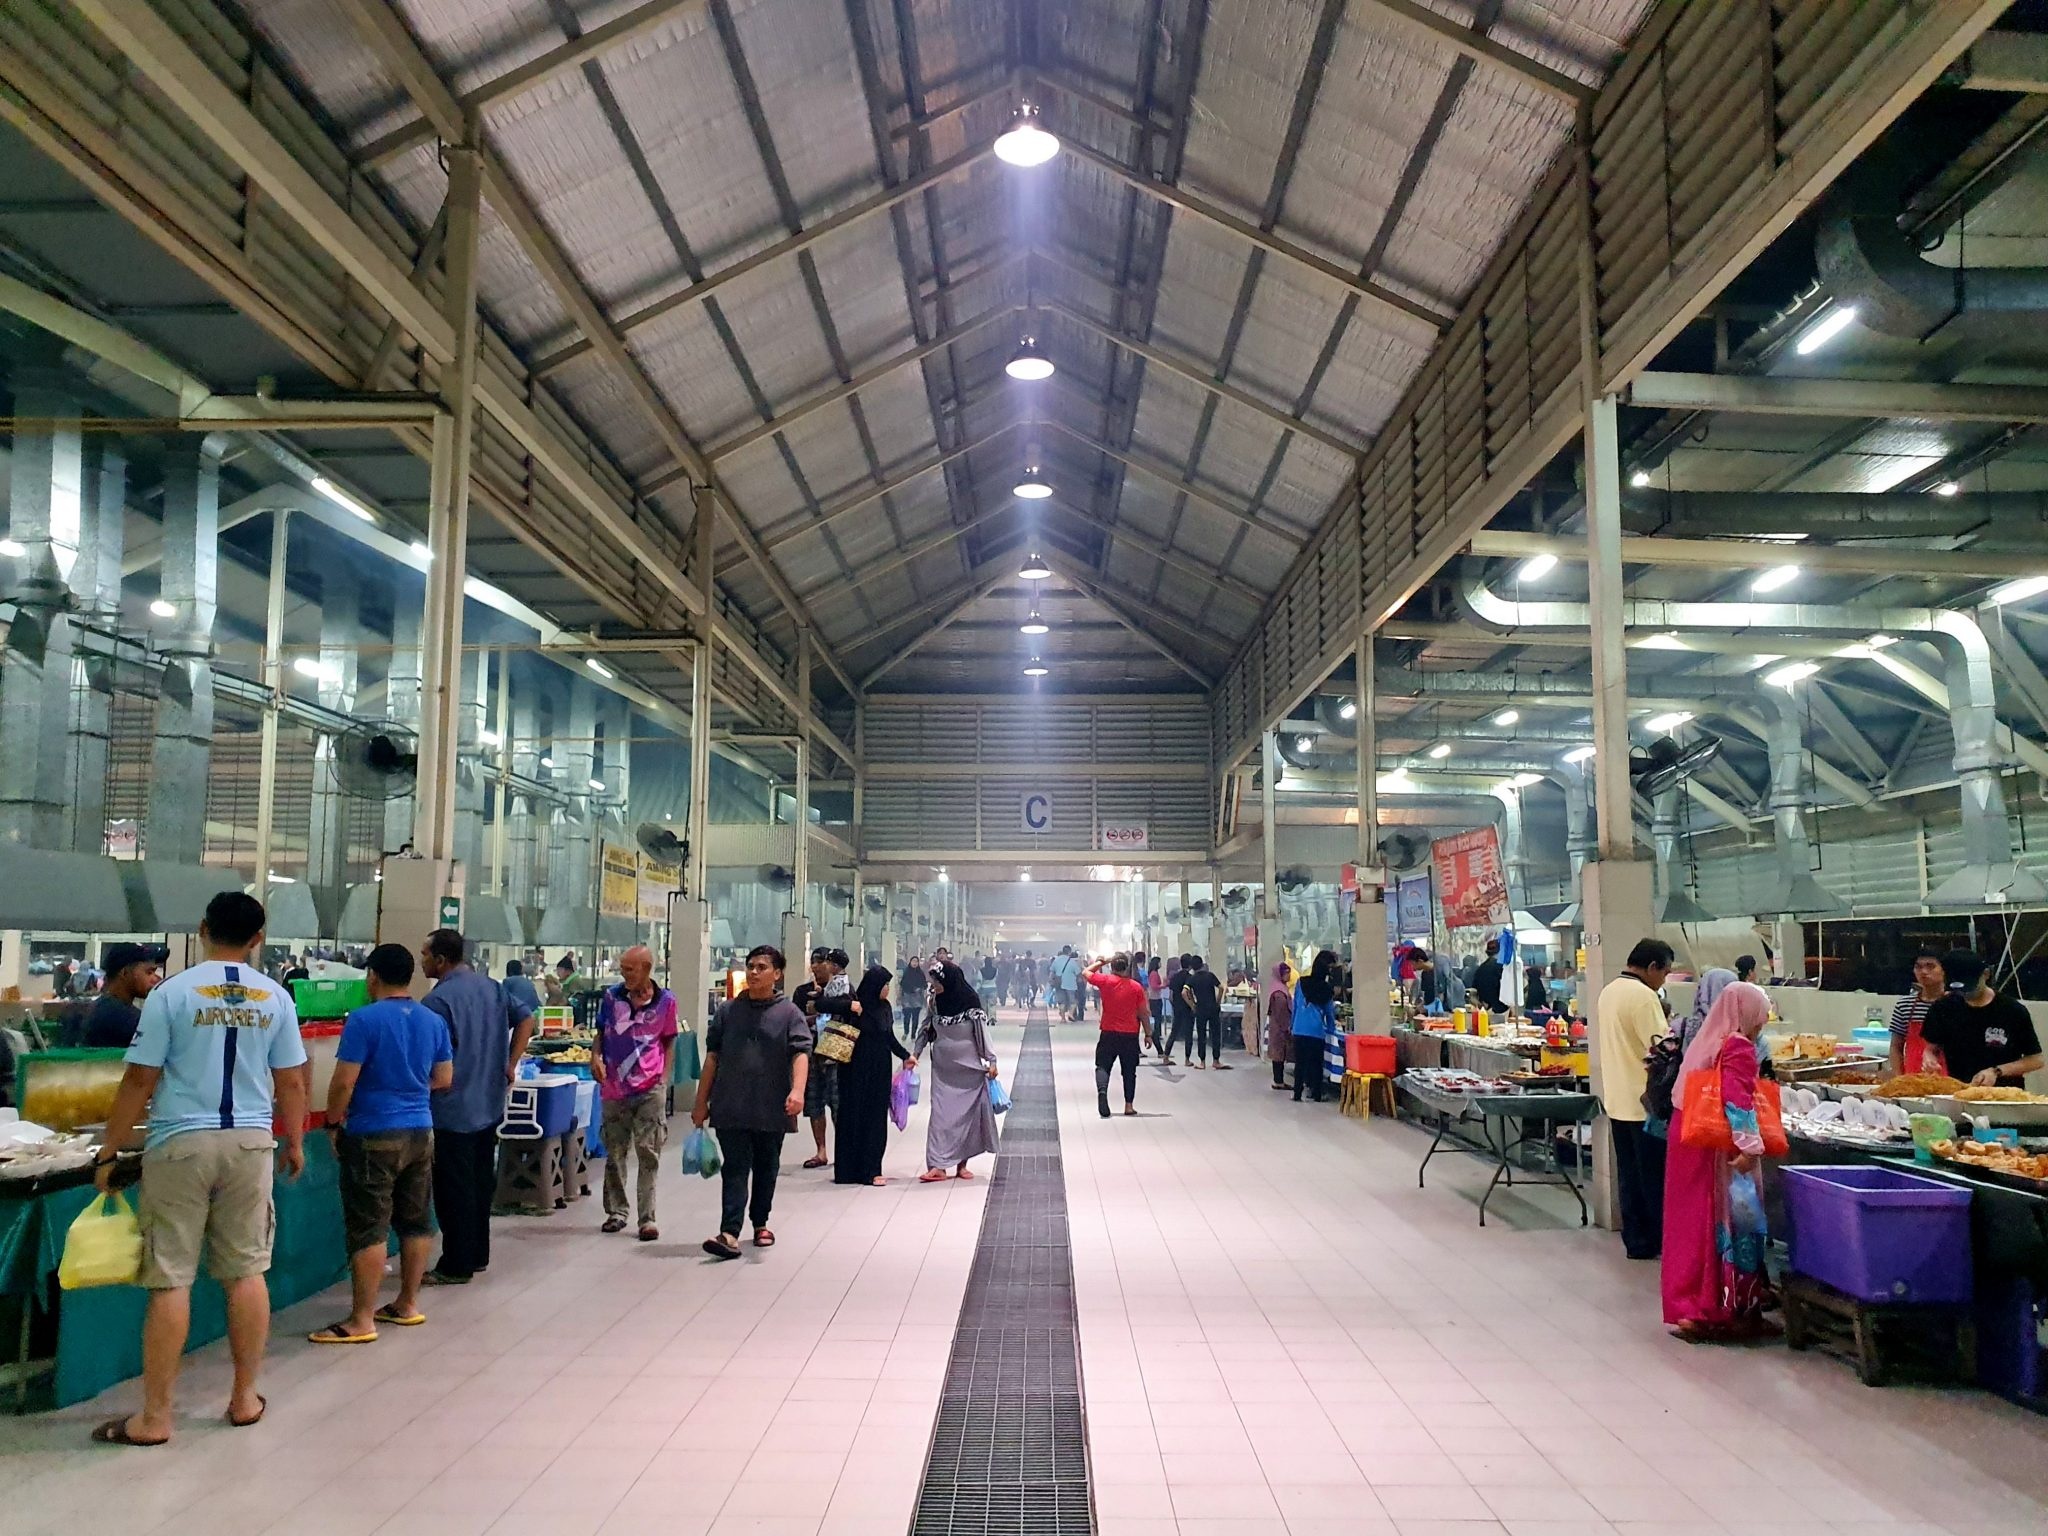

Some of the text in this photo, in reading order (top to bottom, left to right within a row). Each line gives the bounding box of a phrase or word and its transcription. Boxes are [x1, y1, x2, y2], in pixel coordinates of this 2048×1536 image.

[1025, 795, 1047, 828] C
[1035, 894, 1045, 907] B
[193, 1006, 274, 1030] AIRCREW
